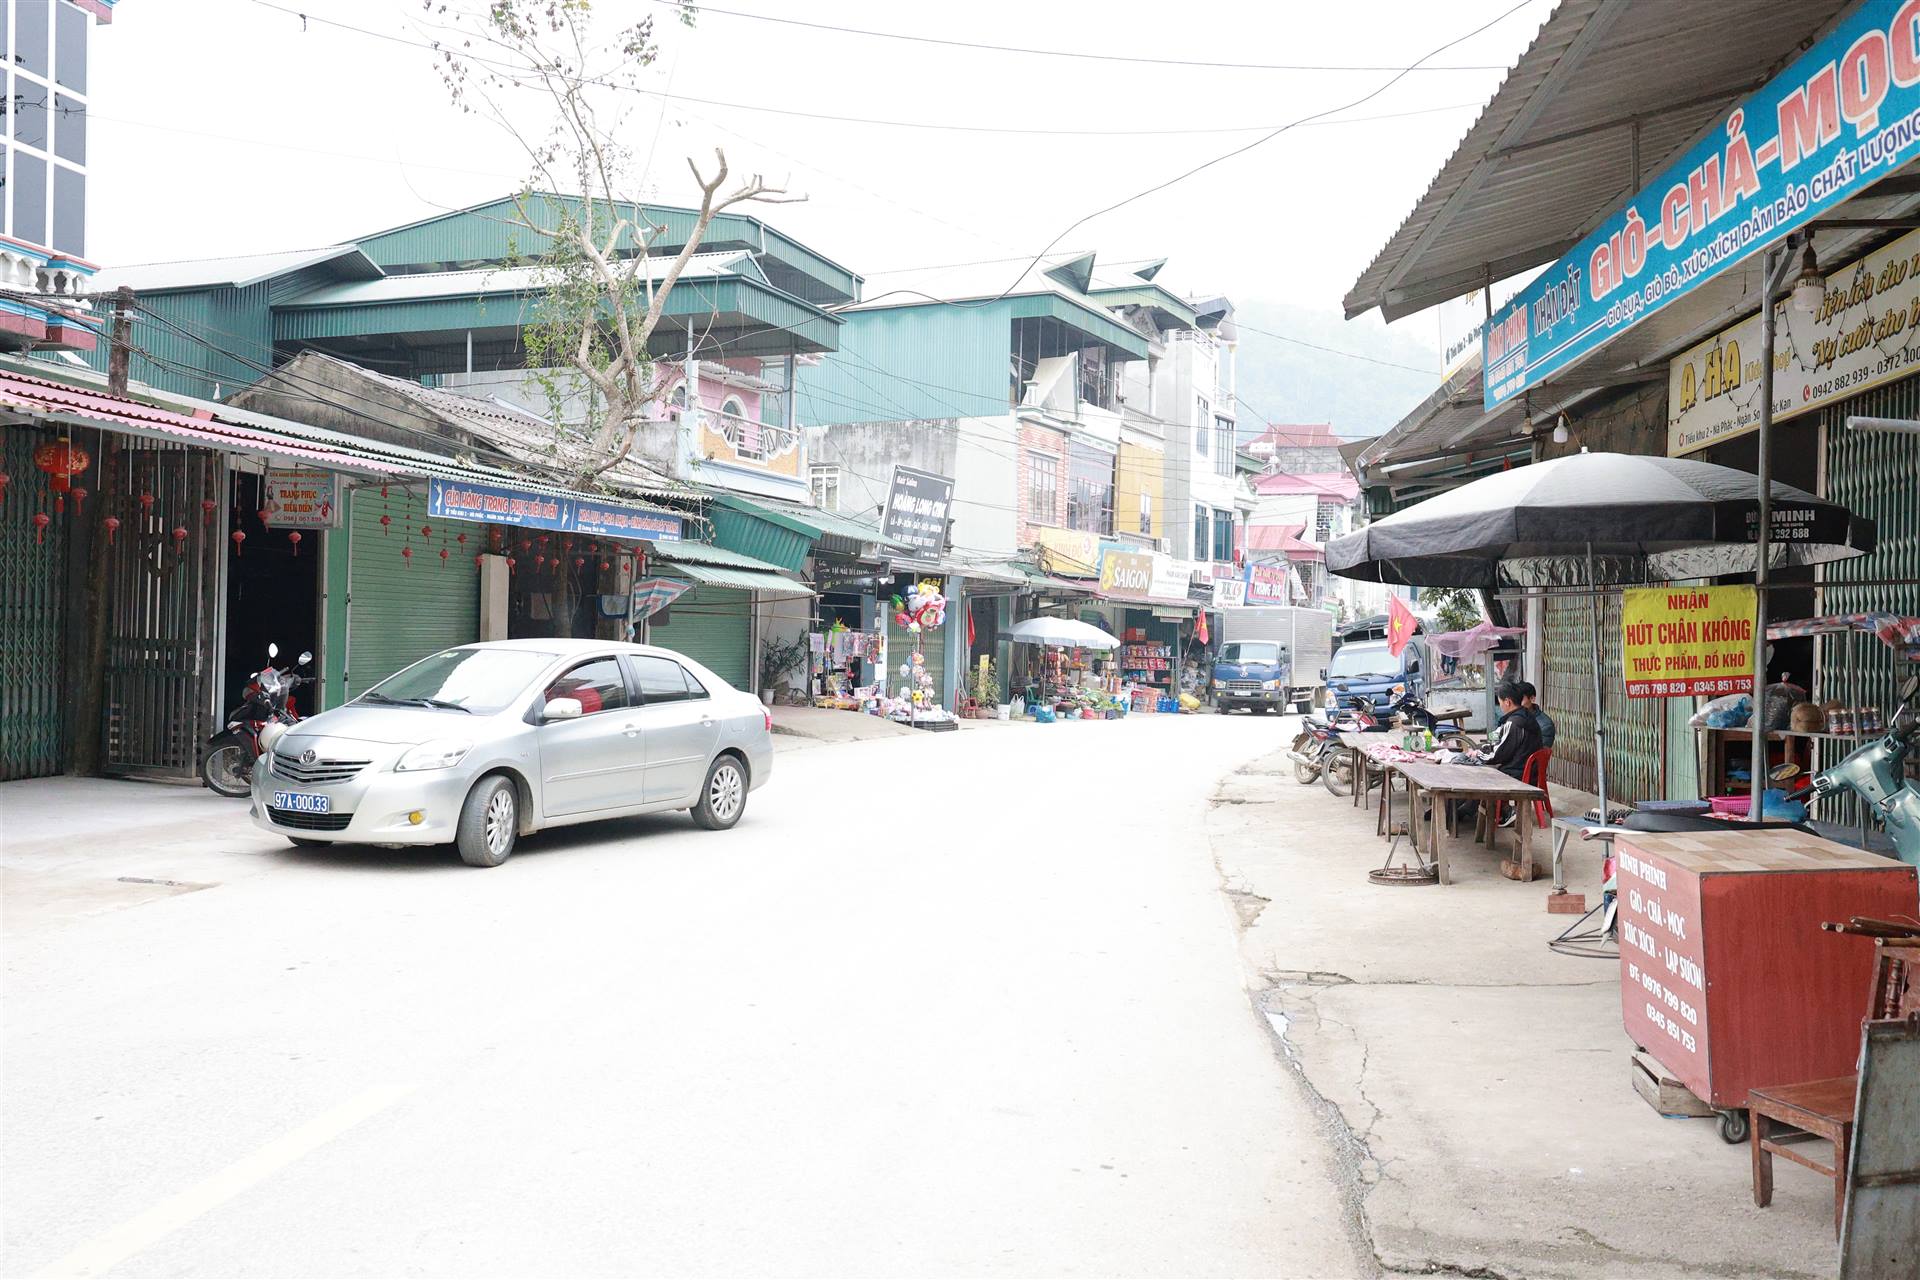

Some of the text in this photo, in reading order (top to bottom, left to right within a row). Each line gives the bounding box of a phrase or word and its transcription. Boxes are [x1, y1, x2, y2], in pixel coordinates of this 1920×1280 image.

[1683, 250, 1708, 283] XÚC
[1709, 233, 1739, 264] XÍCH
[1775, 184, 1808, 224] BẢO
[1811, 148, 1856, 202] CHẤT
[1876, 259, 1908, 295] cho
[1533, 282, 1560, 339] NHẬN
[1875, 308, 1907, 344] cho
[1680, 362, 1697, 412] A
[1812, 382, 1832, 400] 0942
[1834, 374, 1850, 390] 882
[1853, 367, 1869, 385] 939
[1877, 358, 1901, 377] 0372
[483, 494, 508, 513] TRANG
[1771, 510, 1815, 522] MINH
[1113, 566, 1149, 590] SAIGON
[1668, 590, 1709, 612] NHẬN
[1626, 616, 1751, 646] HÚT CHÂN KHÔNG
[1633, 655, 1661, 675] THỰC
[1722, 650, 1745, 668] KHÔ
[1629, 684, 1650, 695] 0976
[1652, 683, 1668, 694] 799
[1669, 682, 1686, 693] 820
[1694, 681, 1715, 692] 0345
[1717, 680, 1733, 691] 851
[1735, 679, 1751, 690] 753
[275, 793, 327, 811] 97A-000.33
[1647, 896, 1663, 927] CHẢ
[1667, 909, 1686, 942] MỌC
[1623, 919, 1639, 947] XÚC
[1638, 927, 1656, 959] XÍCH
[1665, 946, 1679, 977] LẠP
[1642, 972, 1662, 999] 0976
[1663, 987, 1679, 1012] 799
[1680, 1000, 1697, 1026] 820
[1646, 1003, 1696, 1054] 0345 851 753
